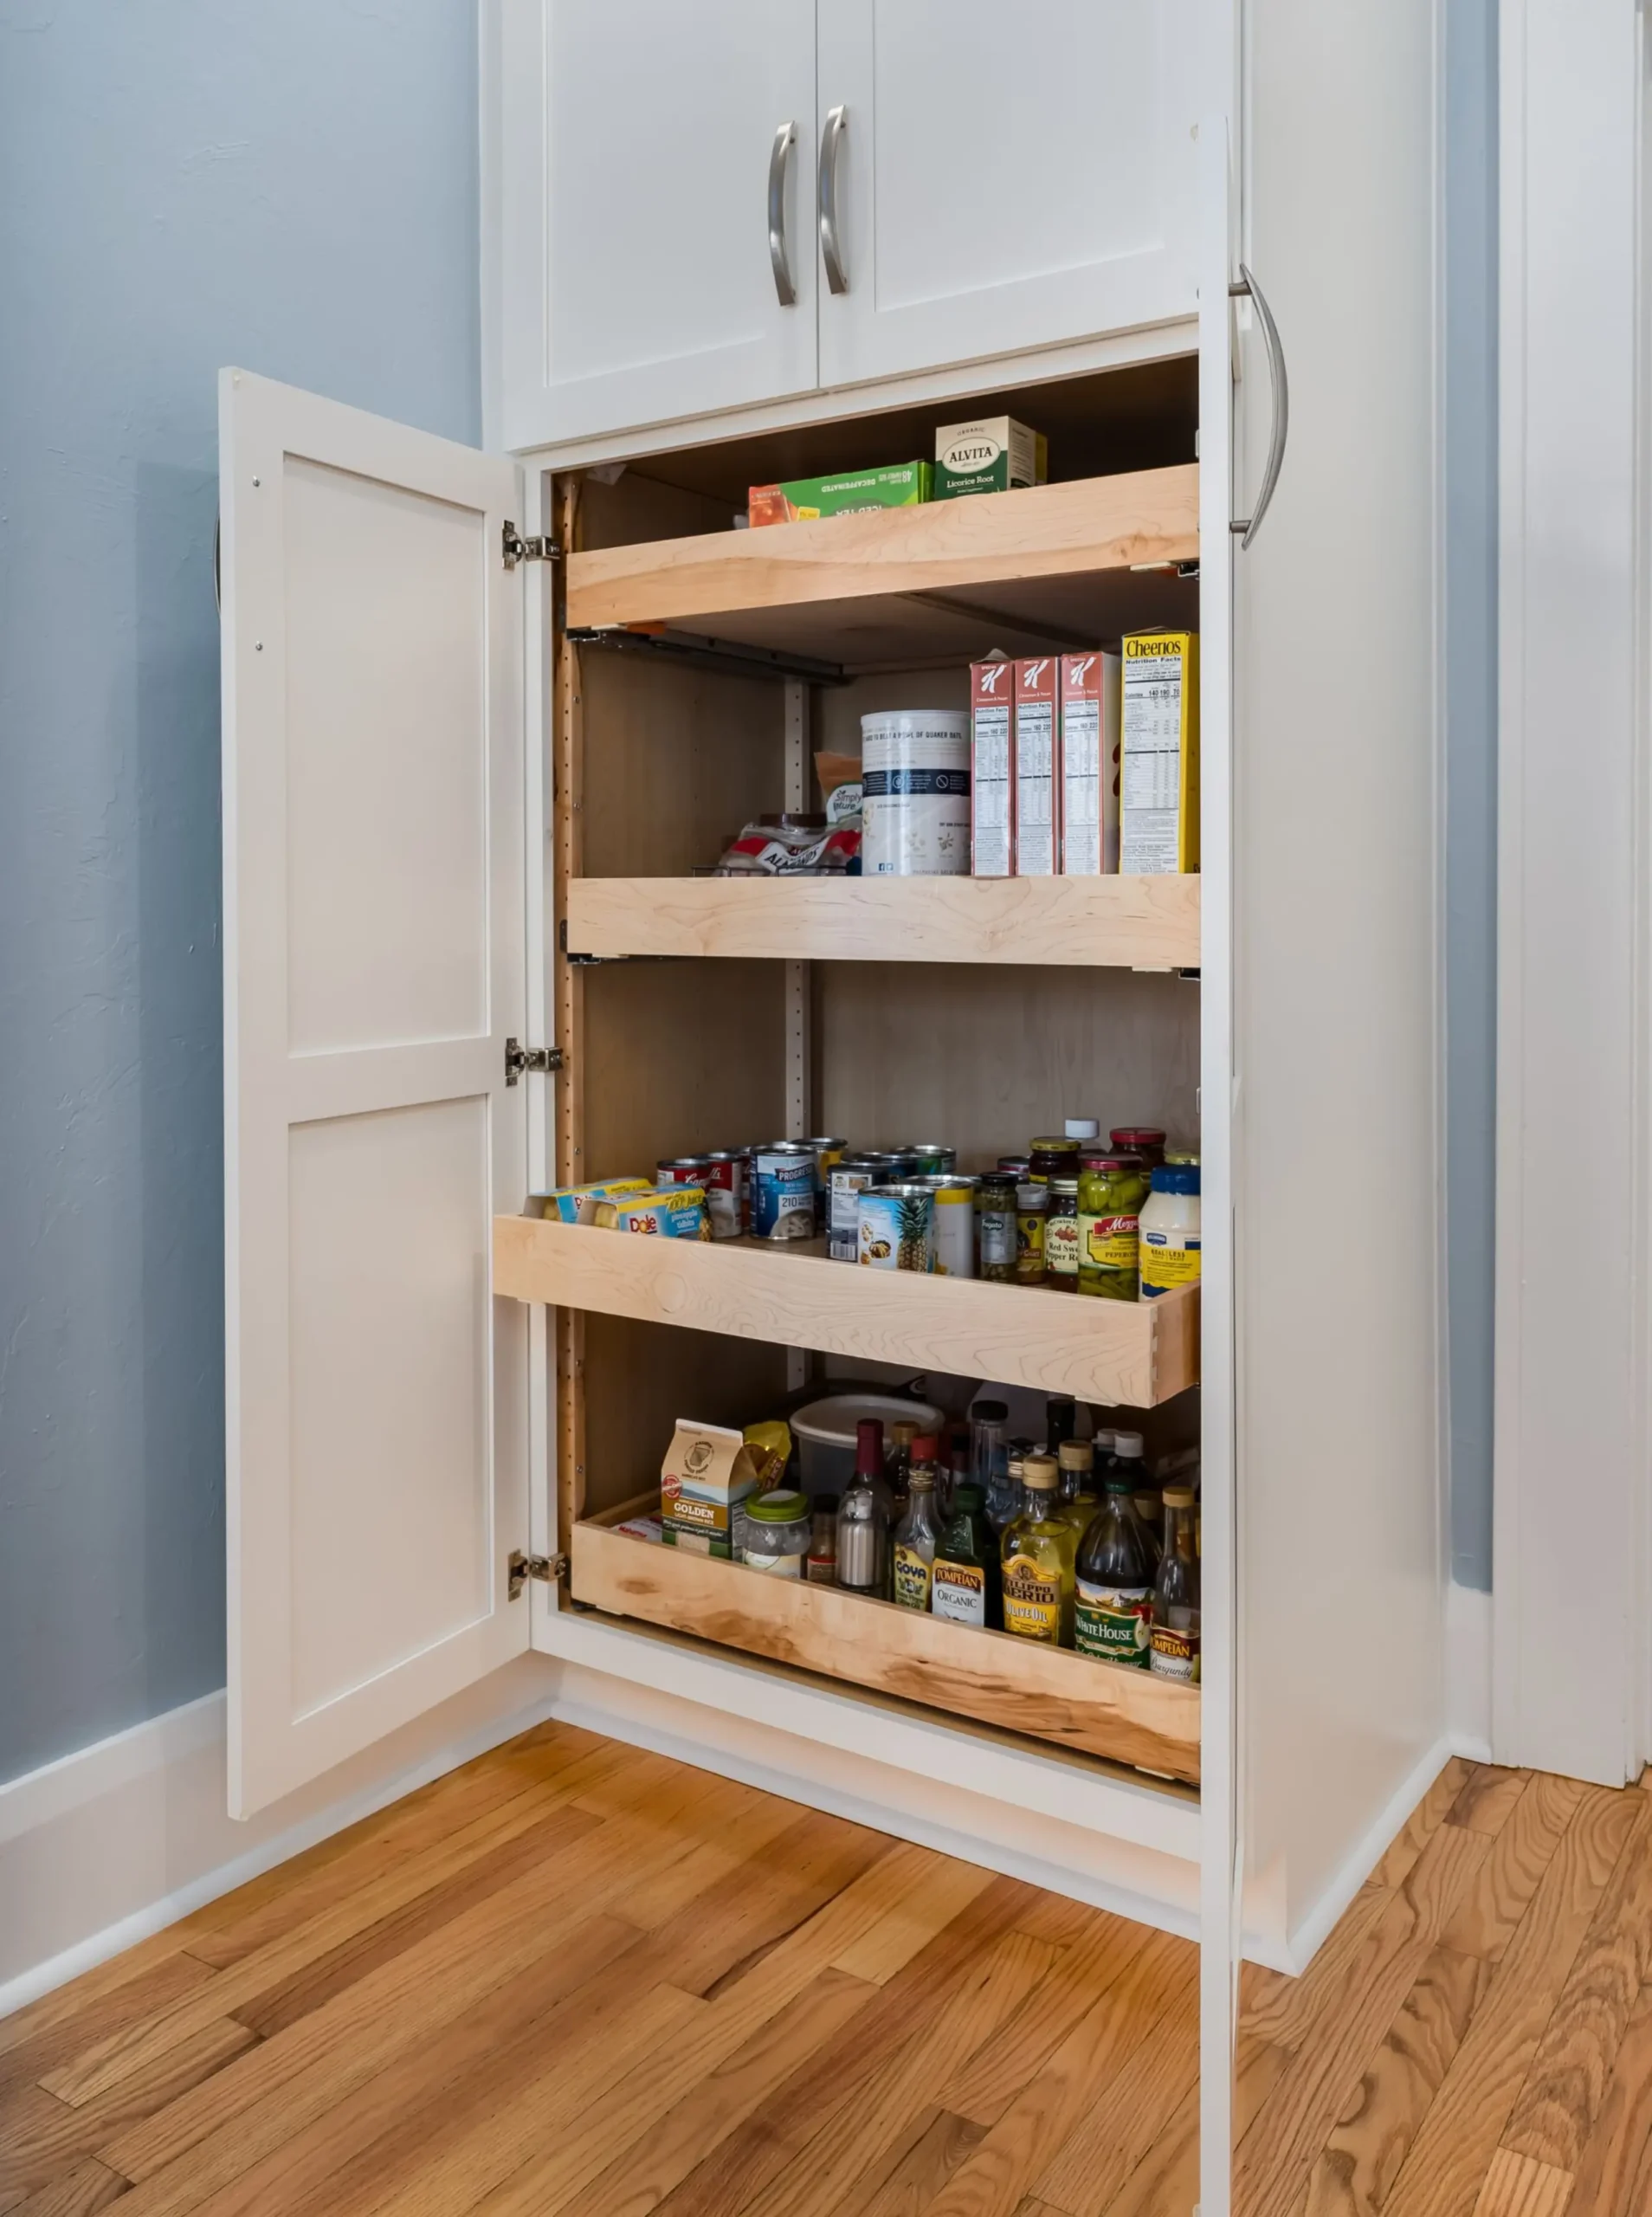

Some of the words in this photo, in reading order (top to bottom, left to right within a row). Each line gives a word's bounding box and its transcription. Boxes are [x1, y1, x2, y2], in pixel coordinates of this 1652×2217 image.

[957, 427, 985, 436] ORGANIC
[949, 446, 992, 462] ALVITA
[901, 469, 913, 483] 48
[946, 477, 976, 488] Licorice
[976, 475, 994, 483] Root
[821, 478, 876, 493] DECAFFEINATED
[1126, 639, 1181, 657] Cheerios
[981, 664, 1005, 694] K
[1023, 659, 1049, 688] K
[1070, 656, 1095, 687] K
[833, 802, 856, 811] ture
[835, 792, 863, 804] Simply
[764, 846, 819, 869] ALMNDS
[778, 1166, 812, 1181] PROGRES
[782, 1197, 797, 1208] 210
[629, 1214, 657, 1233] Dole
[1049, 1242, 1062, 1251] Red
[674, 1502, 714, 1519] GOLDEN
[895, 1561, 926, 1580] GOYA
[937, 1568, 978, 1587] POMPEIAN
[937, 1589, 978, 1608] ORGANIC
[1099, 1623, 1133, 1640] HOUSE
[1152, 1656, 1193, 1679] Burgundy
